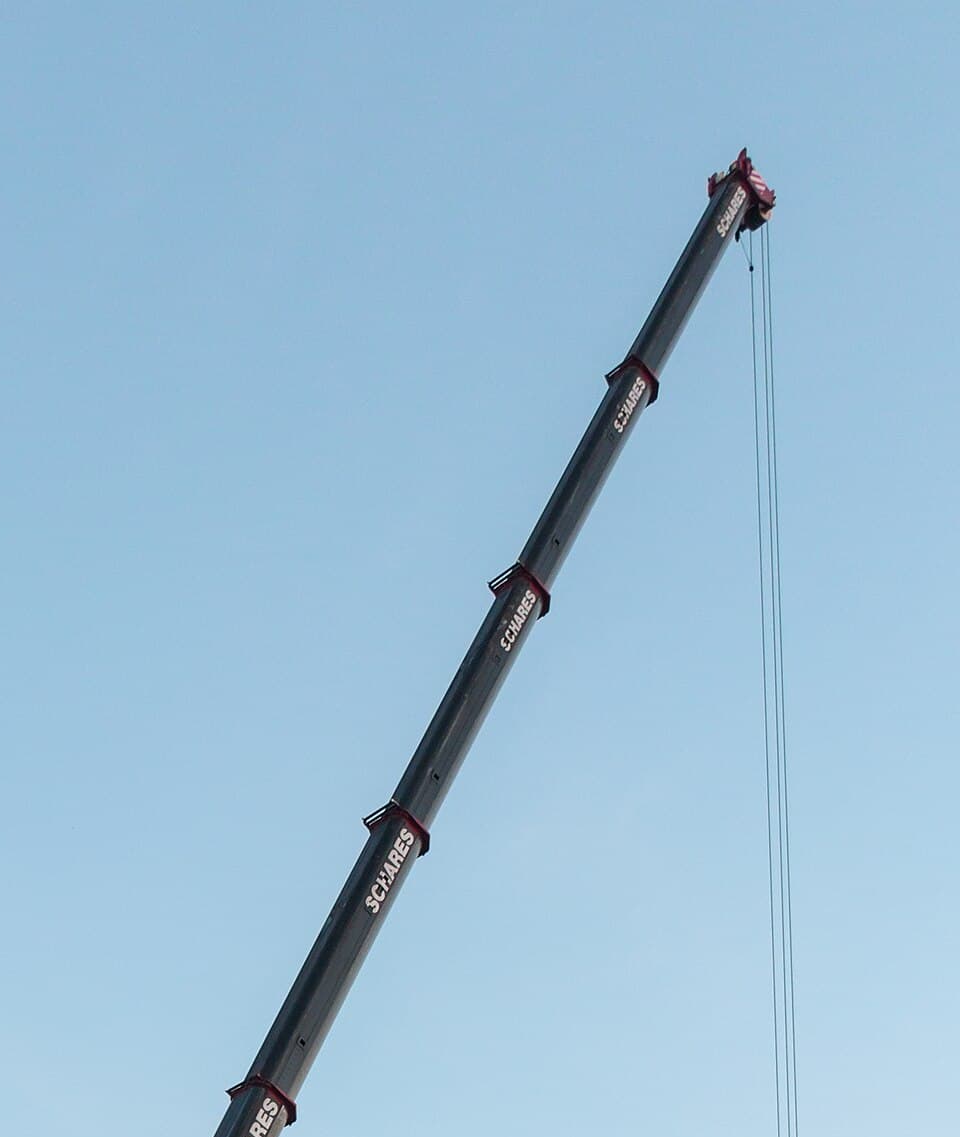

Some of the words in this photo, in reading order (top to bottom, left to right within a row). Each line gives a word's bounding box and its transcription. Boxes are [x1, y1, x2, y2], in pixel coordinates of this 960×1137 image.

[716, 185, 747, 238] SCHARES
[613, 376, 646, 433] SCHARES
[500, 589, 537, 652] SCHARES
[365, 828, 415, 914] SCHARES
